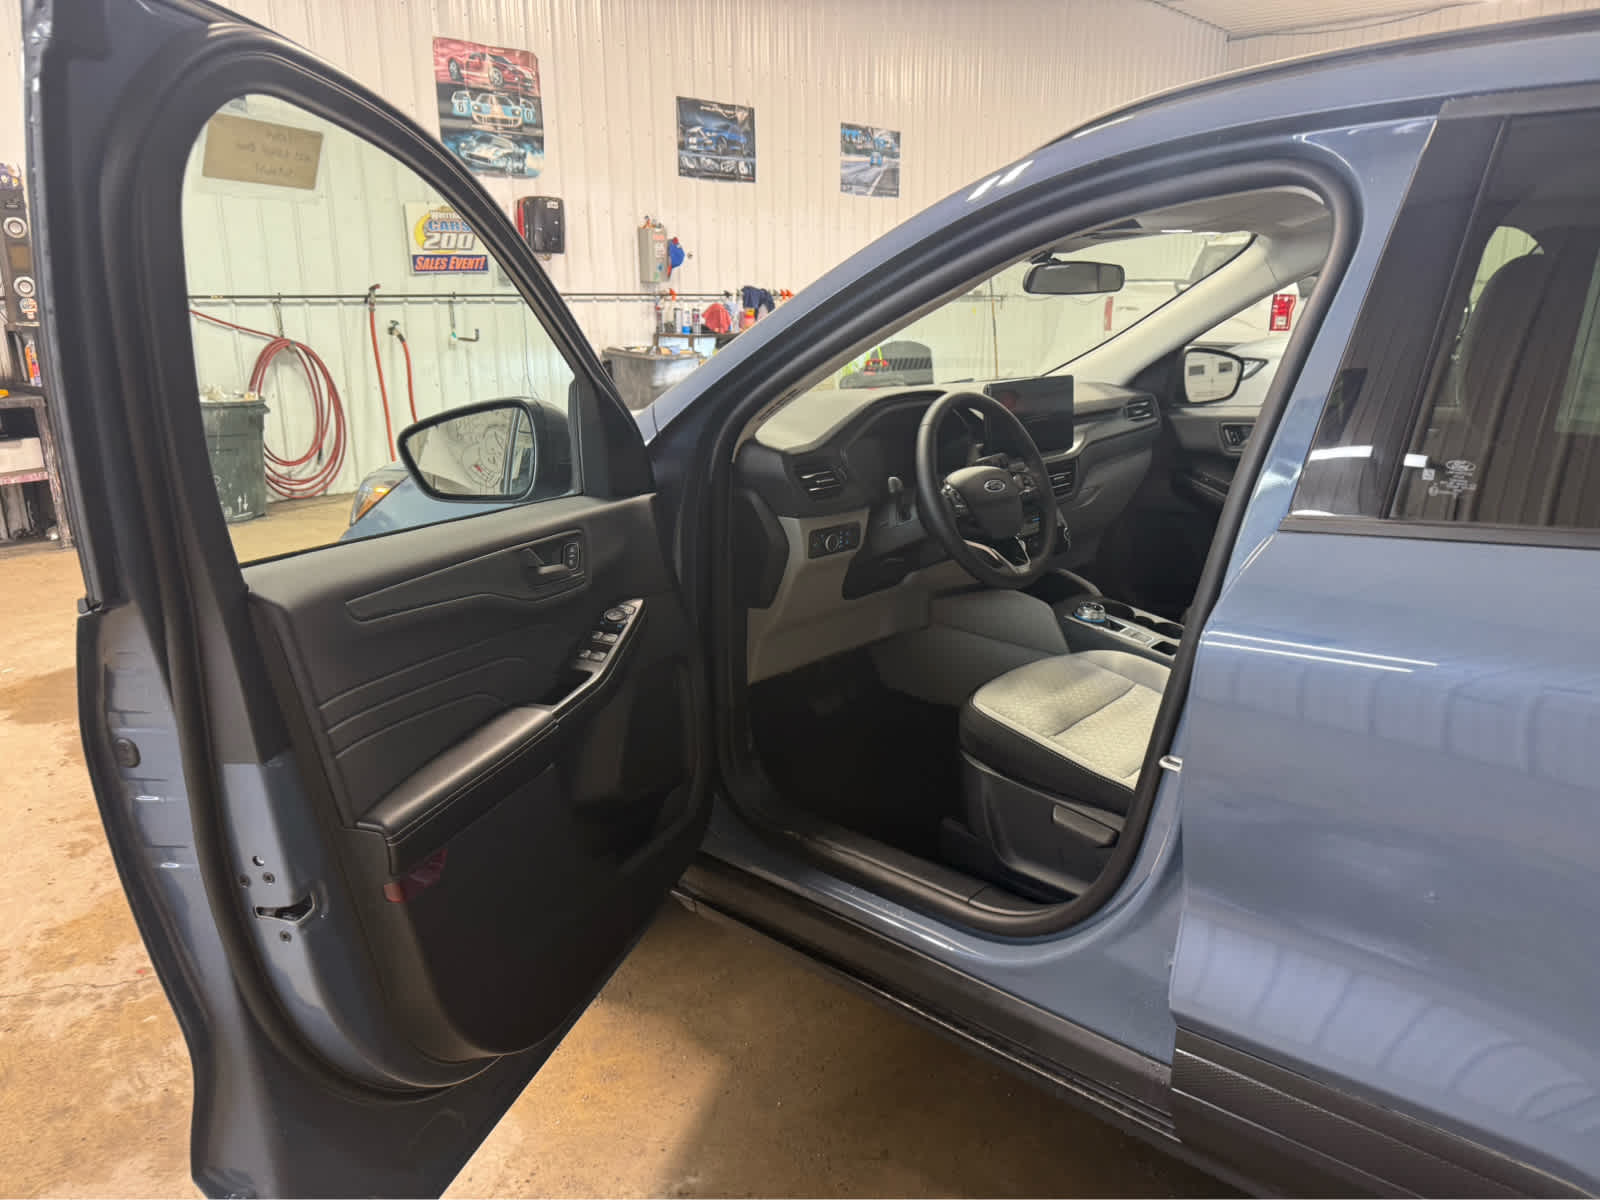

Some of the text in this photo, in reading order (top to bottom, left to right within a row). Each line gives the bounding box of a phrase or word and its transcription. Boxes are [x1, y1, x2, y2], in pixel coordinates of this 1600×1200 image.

[423, 232, 476, 250] 200
[415, 256, 486, 270] SALES EVENT!
